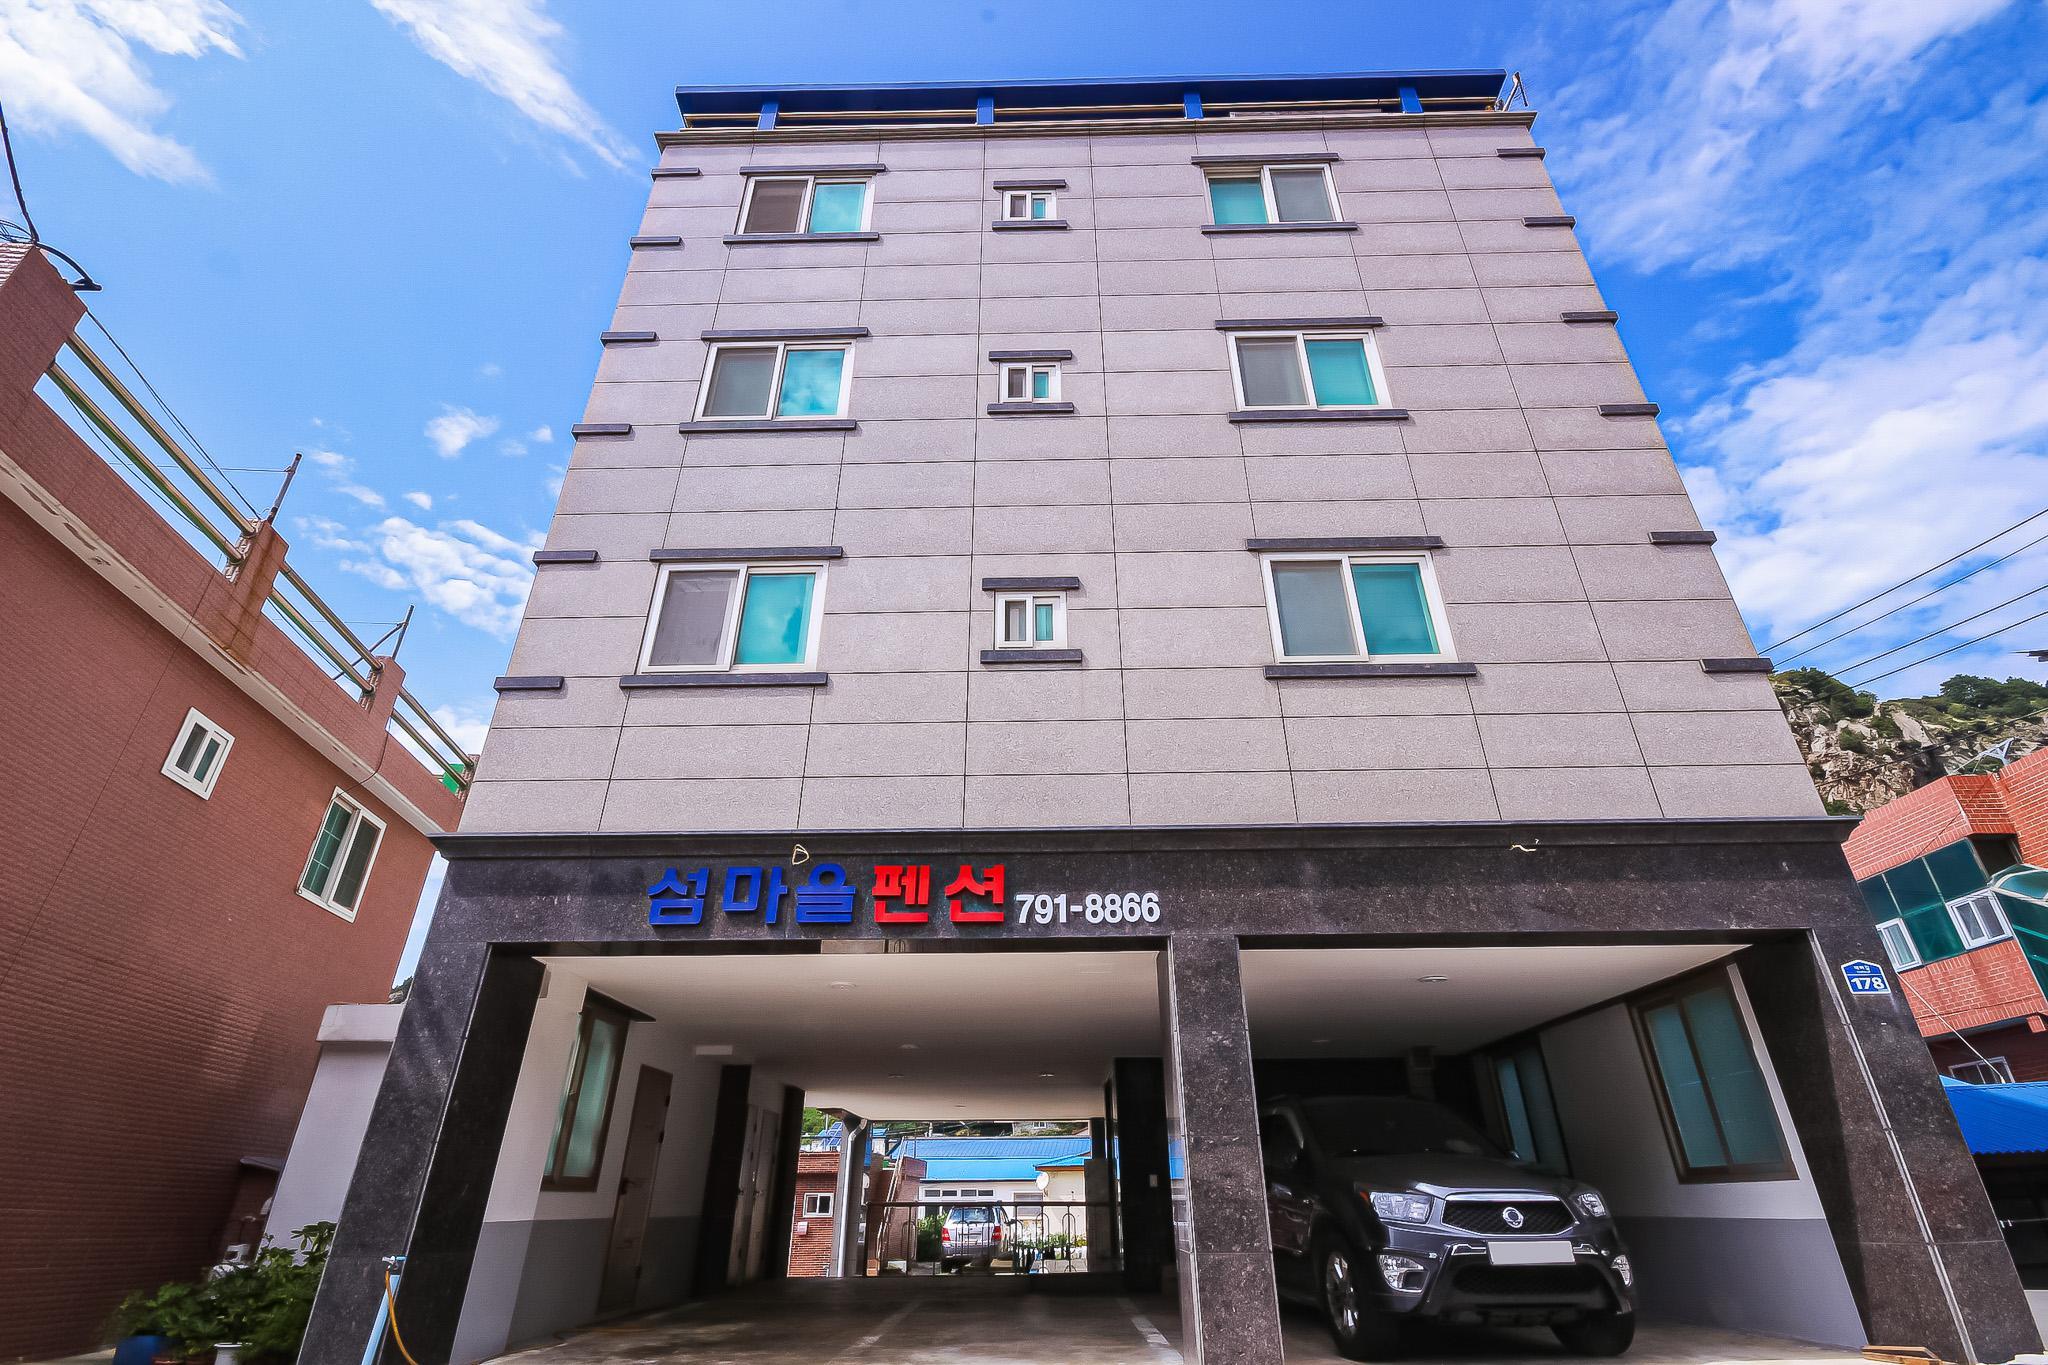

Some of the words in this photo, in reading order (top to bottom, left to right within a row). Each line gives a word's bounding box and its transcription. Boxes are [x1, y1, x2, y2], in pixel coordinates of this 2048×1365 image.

[648, 863, 856, 925] 섬마을
[872, 864, 1005, 923] 펜션
[1015, 892, 1161, 924] 791-8866
[1851, 977, 1885, 990] 178
